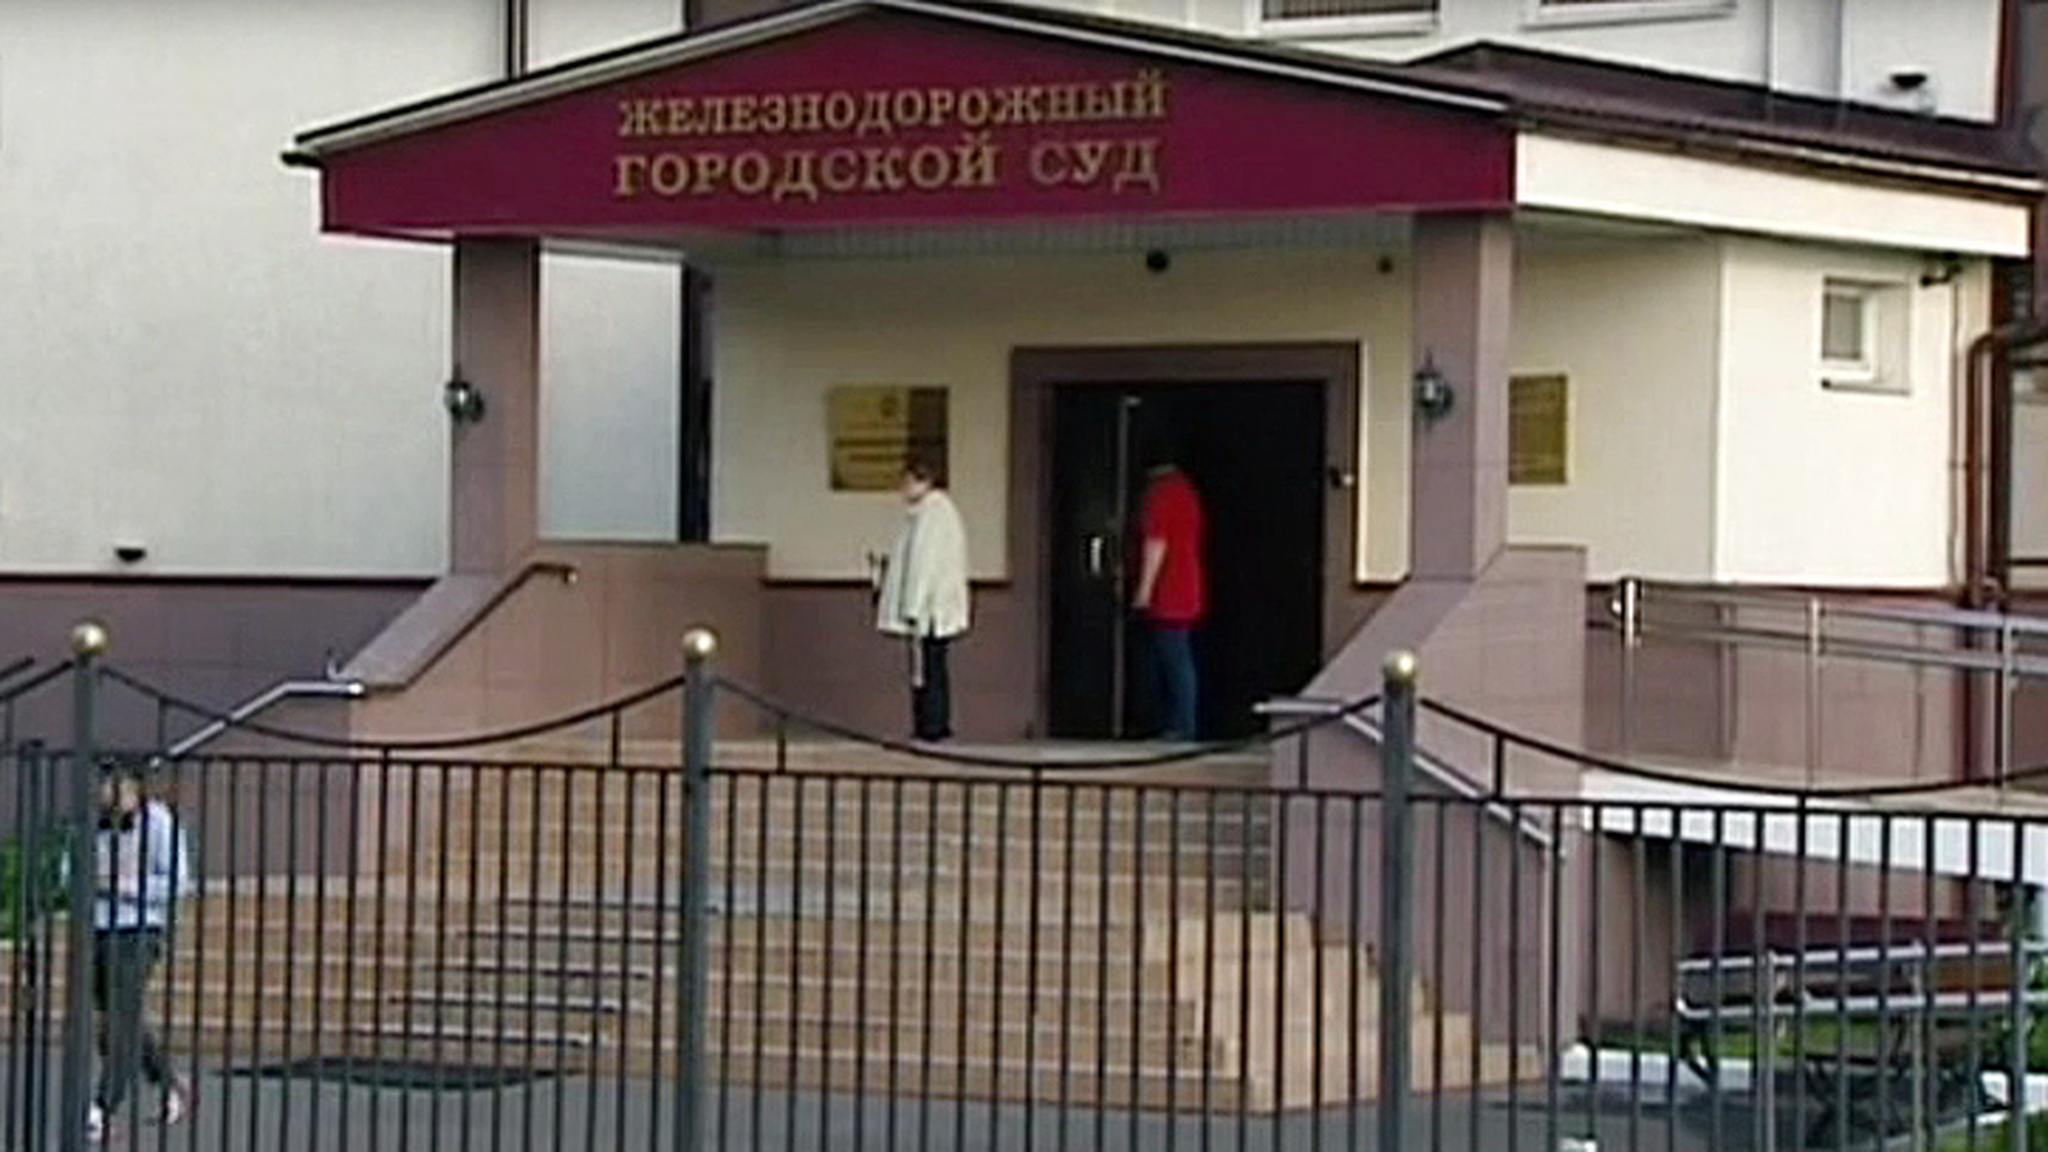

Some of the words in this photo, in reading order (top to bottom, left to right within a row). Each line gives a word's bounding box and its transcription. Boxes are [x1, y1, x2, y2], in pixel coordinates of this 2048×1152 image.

[618, 69, 1166, 138] ЖЕЛЕЗНОДОРОЖНЫЙ
[613, 132, 999, 202] ГОРОДСКОЙ
[1030, 136, 1161, 193] СУД
